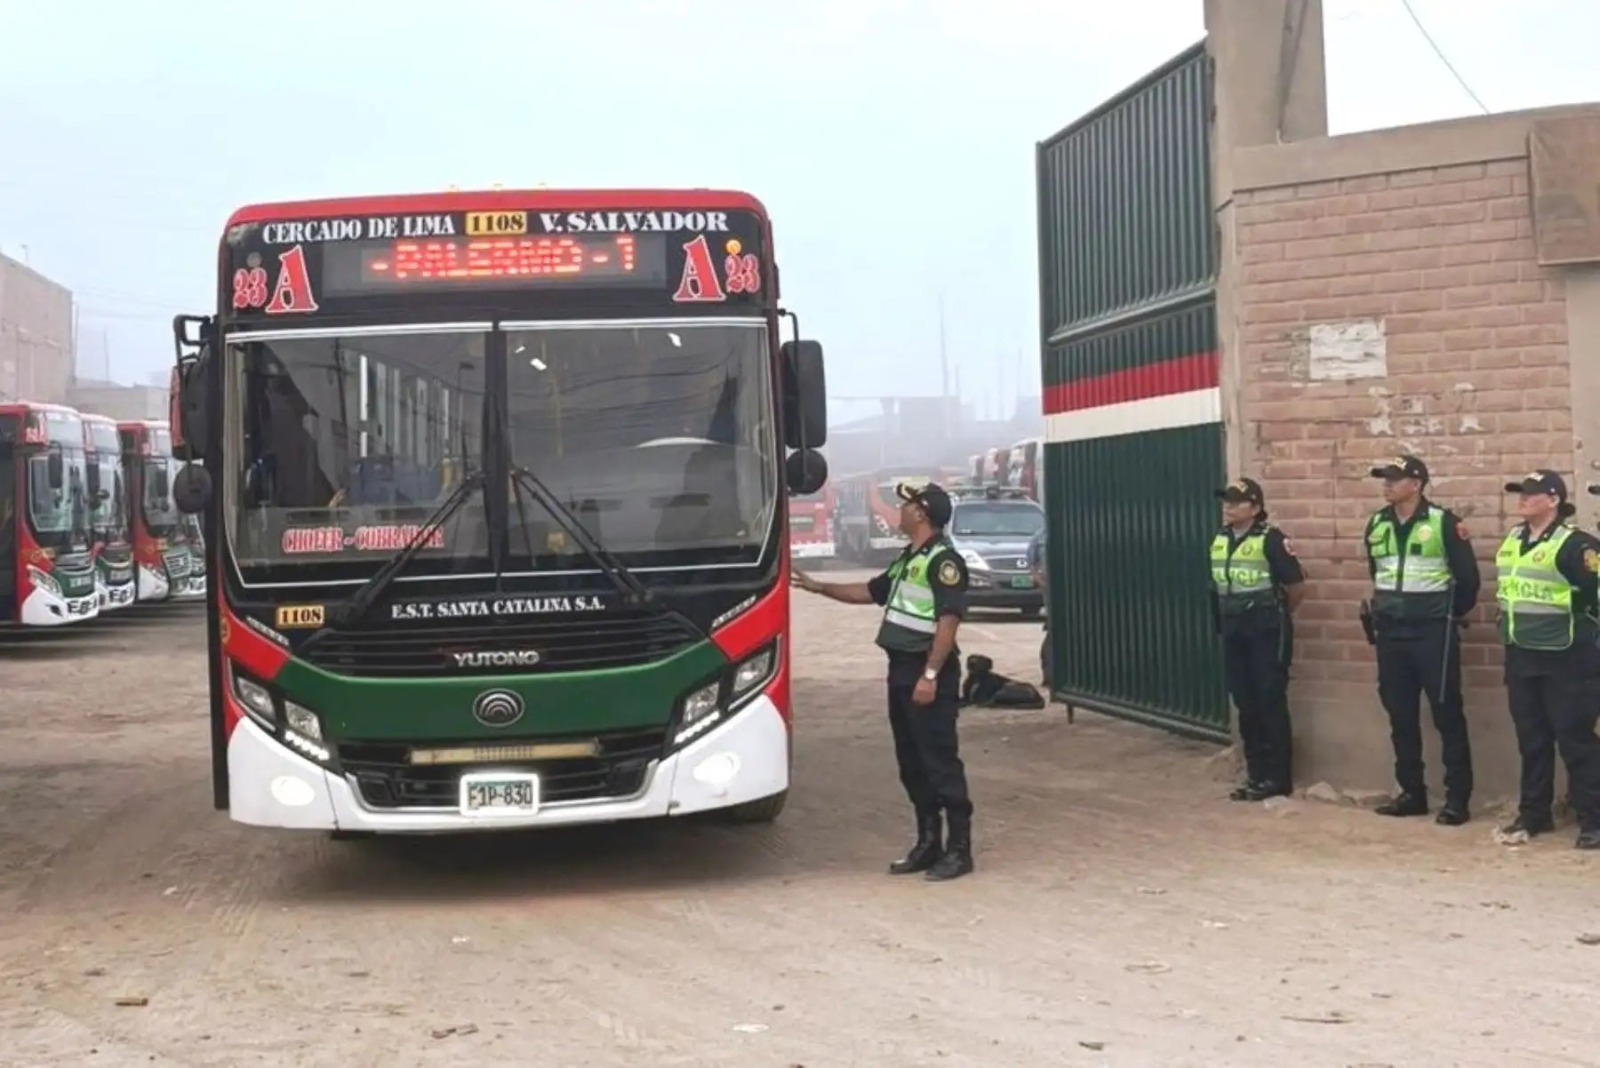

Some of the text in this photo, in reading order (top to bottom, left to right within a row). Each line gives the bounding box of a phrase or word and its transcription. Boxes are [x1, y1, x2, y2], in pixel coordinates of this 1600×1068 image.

[262, 214, 456, 244] CERCADO DE LIMA
[472, 213, 525, 232] 1108
[232, 244, 319, 313] 23 A
[672, 234, 761, 302] A 23
[282, 608, 321, 623] 1108
[437, 600, 490, 617] SANTA
[493, 597, 572, 615] CATALINA
[575, 596, 606, 611] S.A.
[454, 650, 541, 668] YUTONG
